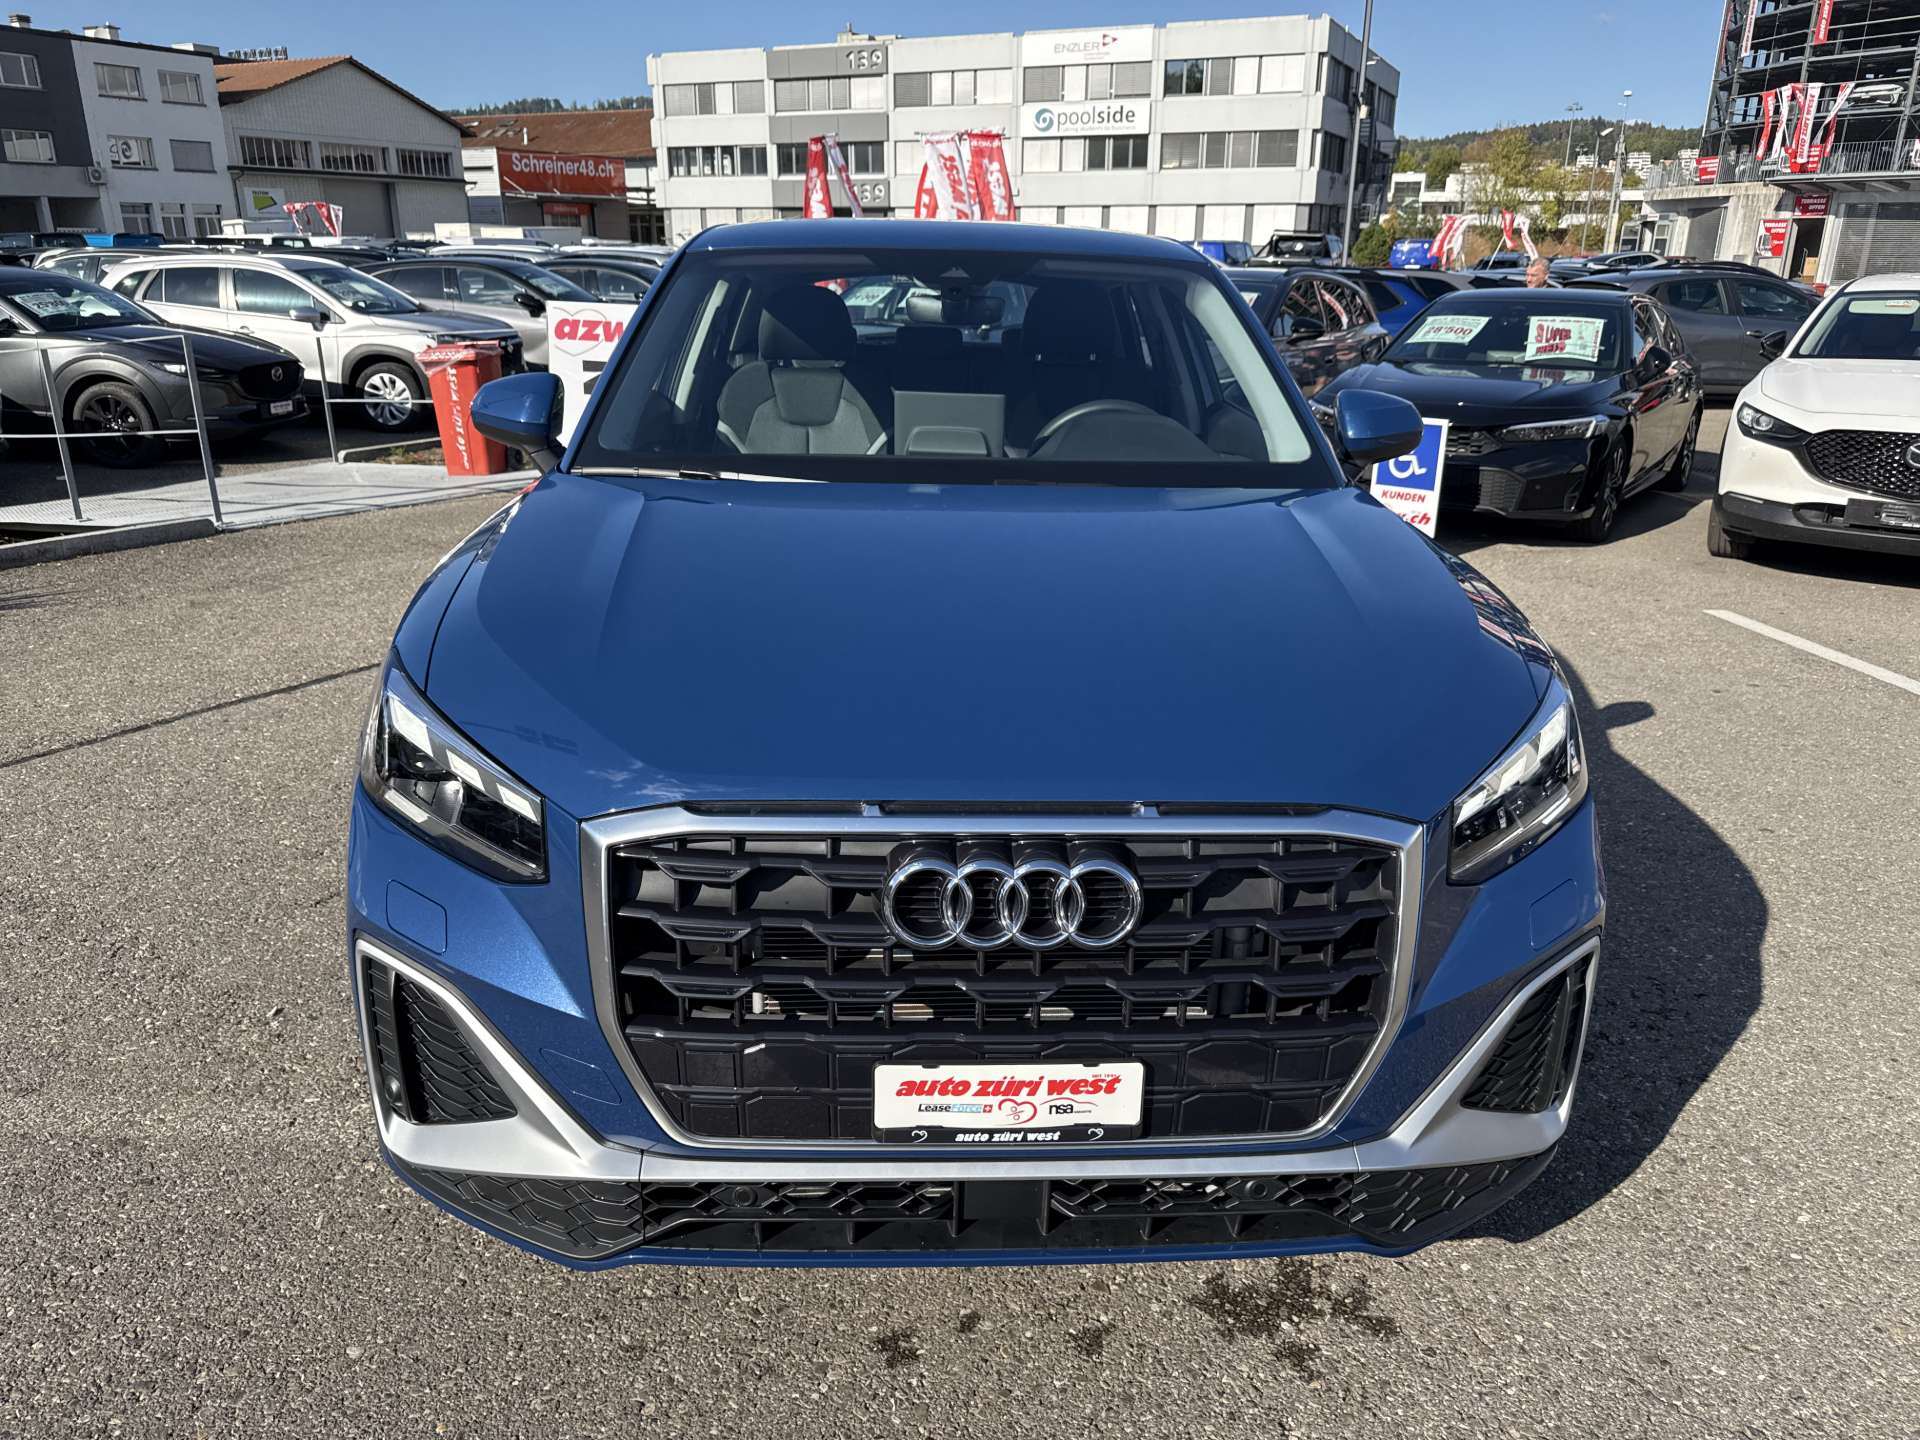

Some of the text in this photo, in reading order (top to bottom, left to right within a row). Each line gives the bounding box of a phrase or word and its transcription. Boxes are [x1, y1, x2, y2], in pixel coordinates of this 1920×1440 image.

[1054, 41, 1100, 54] ENZLER
[846, 49, 882, 70] 139
[1057, 105, 1136, 133] poolside
[512, 152, 614, 178] Schreiner48.ch
[1380, 489, 1427, 503] KUNDEN
[896, 1075, 1122, 1097] auto züri west
[918, 1103, 982, 1114] LeaseForce
[1049, 1103, 1074, 1115] nsa
[955, 1131, 1061, 1142] auto züri west
